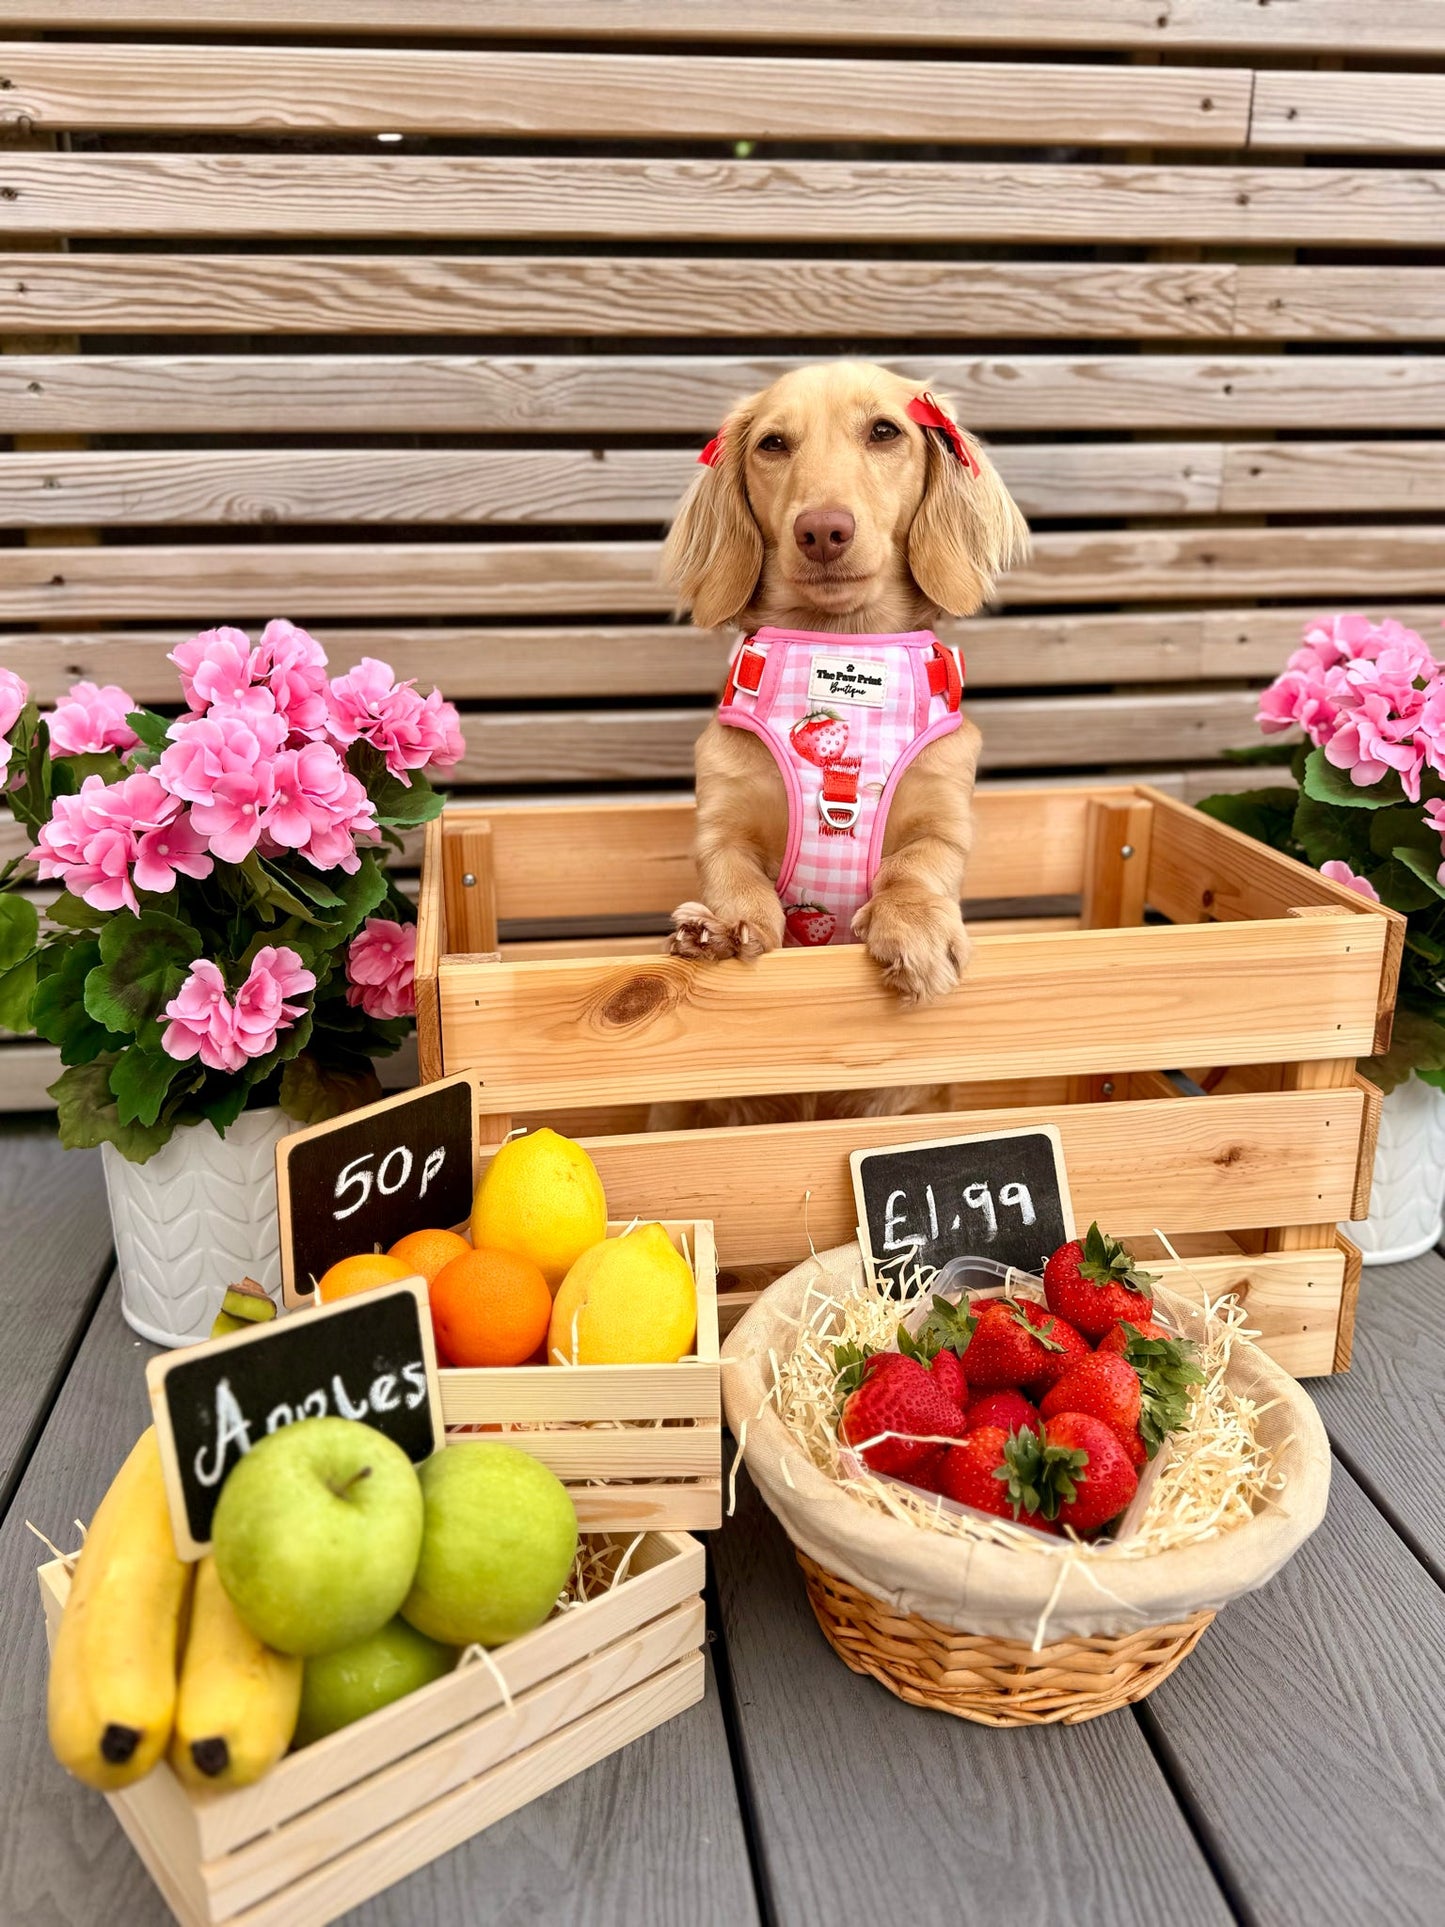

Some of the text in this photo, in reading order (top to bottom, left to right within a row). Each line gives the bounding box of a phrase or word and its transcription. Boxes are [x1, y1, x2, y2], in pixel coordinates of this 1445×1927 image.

[816, 669, 882, 686] The Paw Print
[829, 681, 867, 698] Boutique
[333, 1145, 446, 1220] 50p
[883, 1179, 1037, 1250] £1.99
